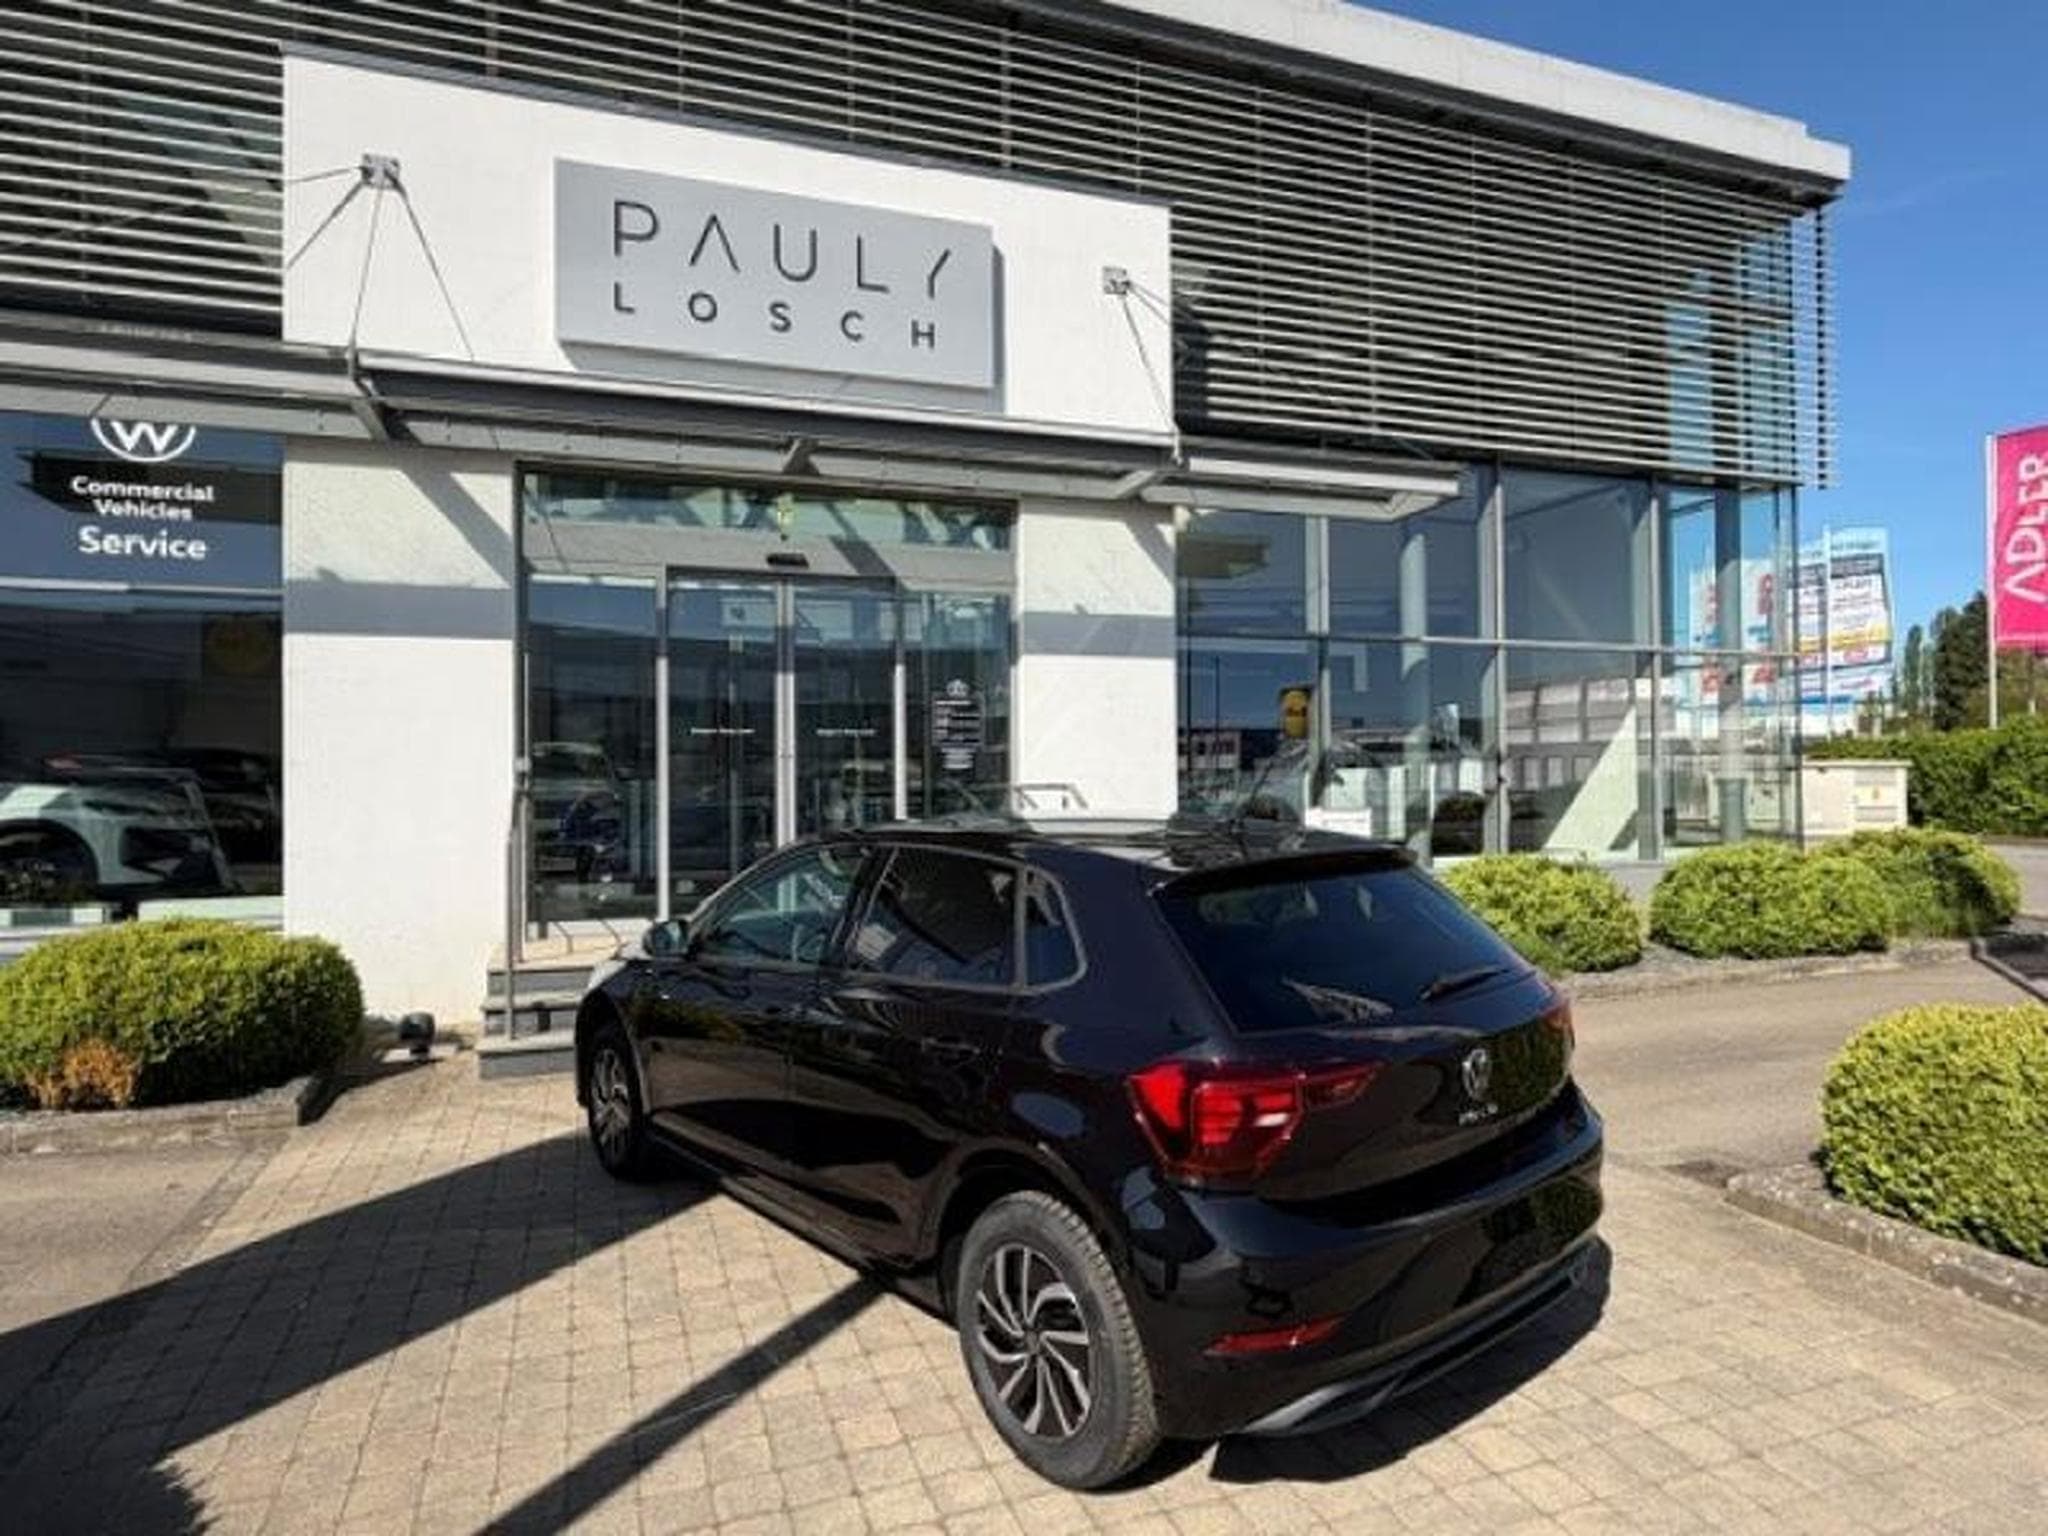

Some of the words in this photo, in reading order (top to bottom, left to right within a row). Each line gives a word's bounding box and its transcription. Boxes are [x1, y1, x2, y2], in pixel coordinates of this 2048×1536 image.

[614, 201, 950, 298] PAULY
[614, 283, 935, 347] LOSCH
[72, 475, 213, 501] Commercial
[93, 499, 193, 521] Vehicles
[79, 526, 207, 559] Service
